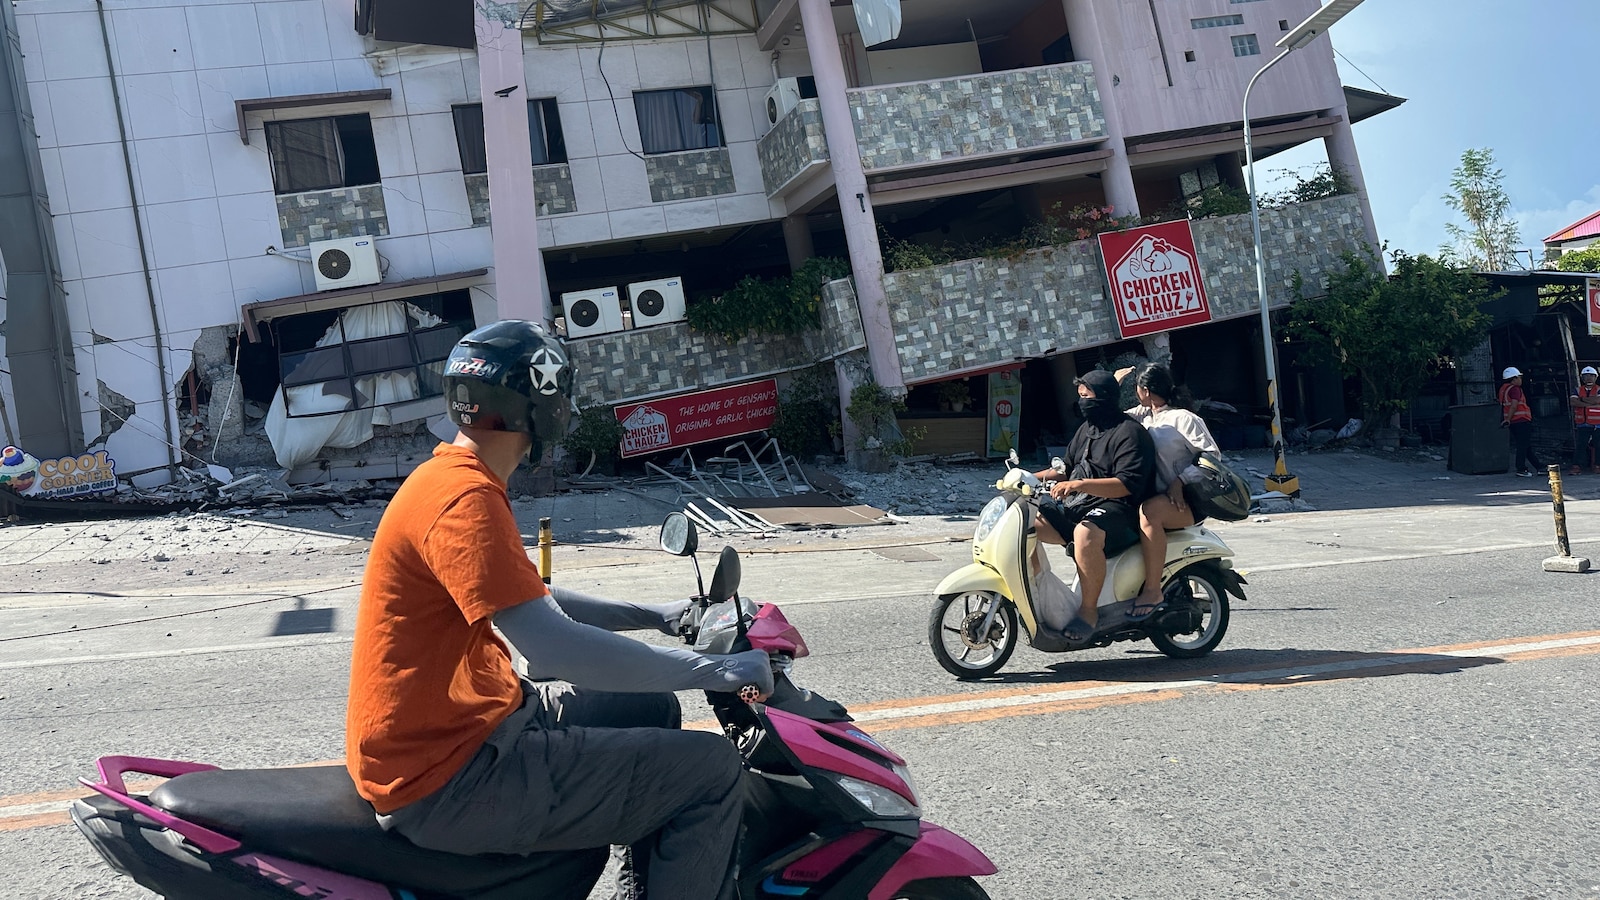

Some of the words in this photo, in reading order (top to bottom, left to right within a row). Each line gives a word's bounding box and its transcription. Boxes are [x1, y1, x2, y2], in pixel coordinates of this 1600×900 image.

[1122, 270, 1192, 299] CHICKEN
[1140, 291, 1183, 316] HAUZ
[679, 405, 695, 417] THE
[697, 400, 722, 414] HOME
[724, 398, 734, 409] OF
[737, 390, 776, 405] GENSAN'S
[625, 423, 665, 440] CHICKEN
[675, 420, 713, 434] ORIGINAL
[716, 412, 744, 425] GARLIC
[635, 435, 660, 448] HAUZ
[39, 451, 113, 478] COOL
[41, 468, 113, 490] CORNER
[75, 484, 90, 493] AND
[92, 480, 114, 489] COFFEE
